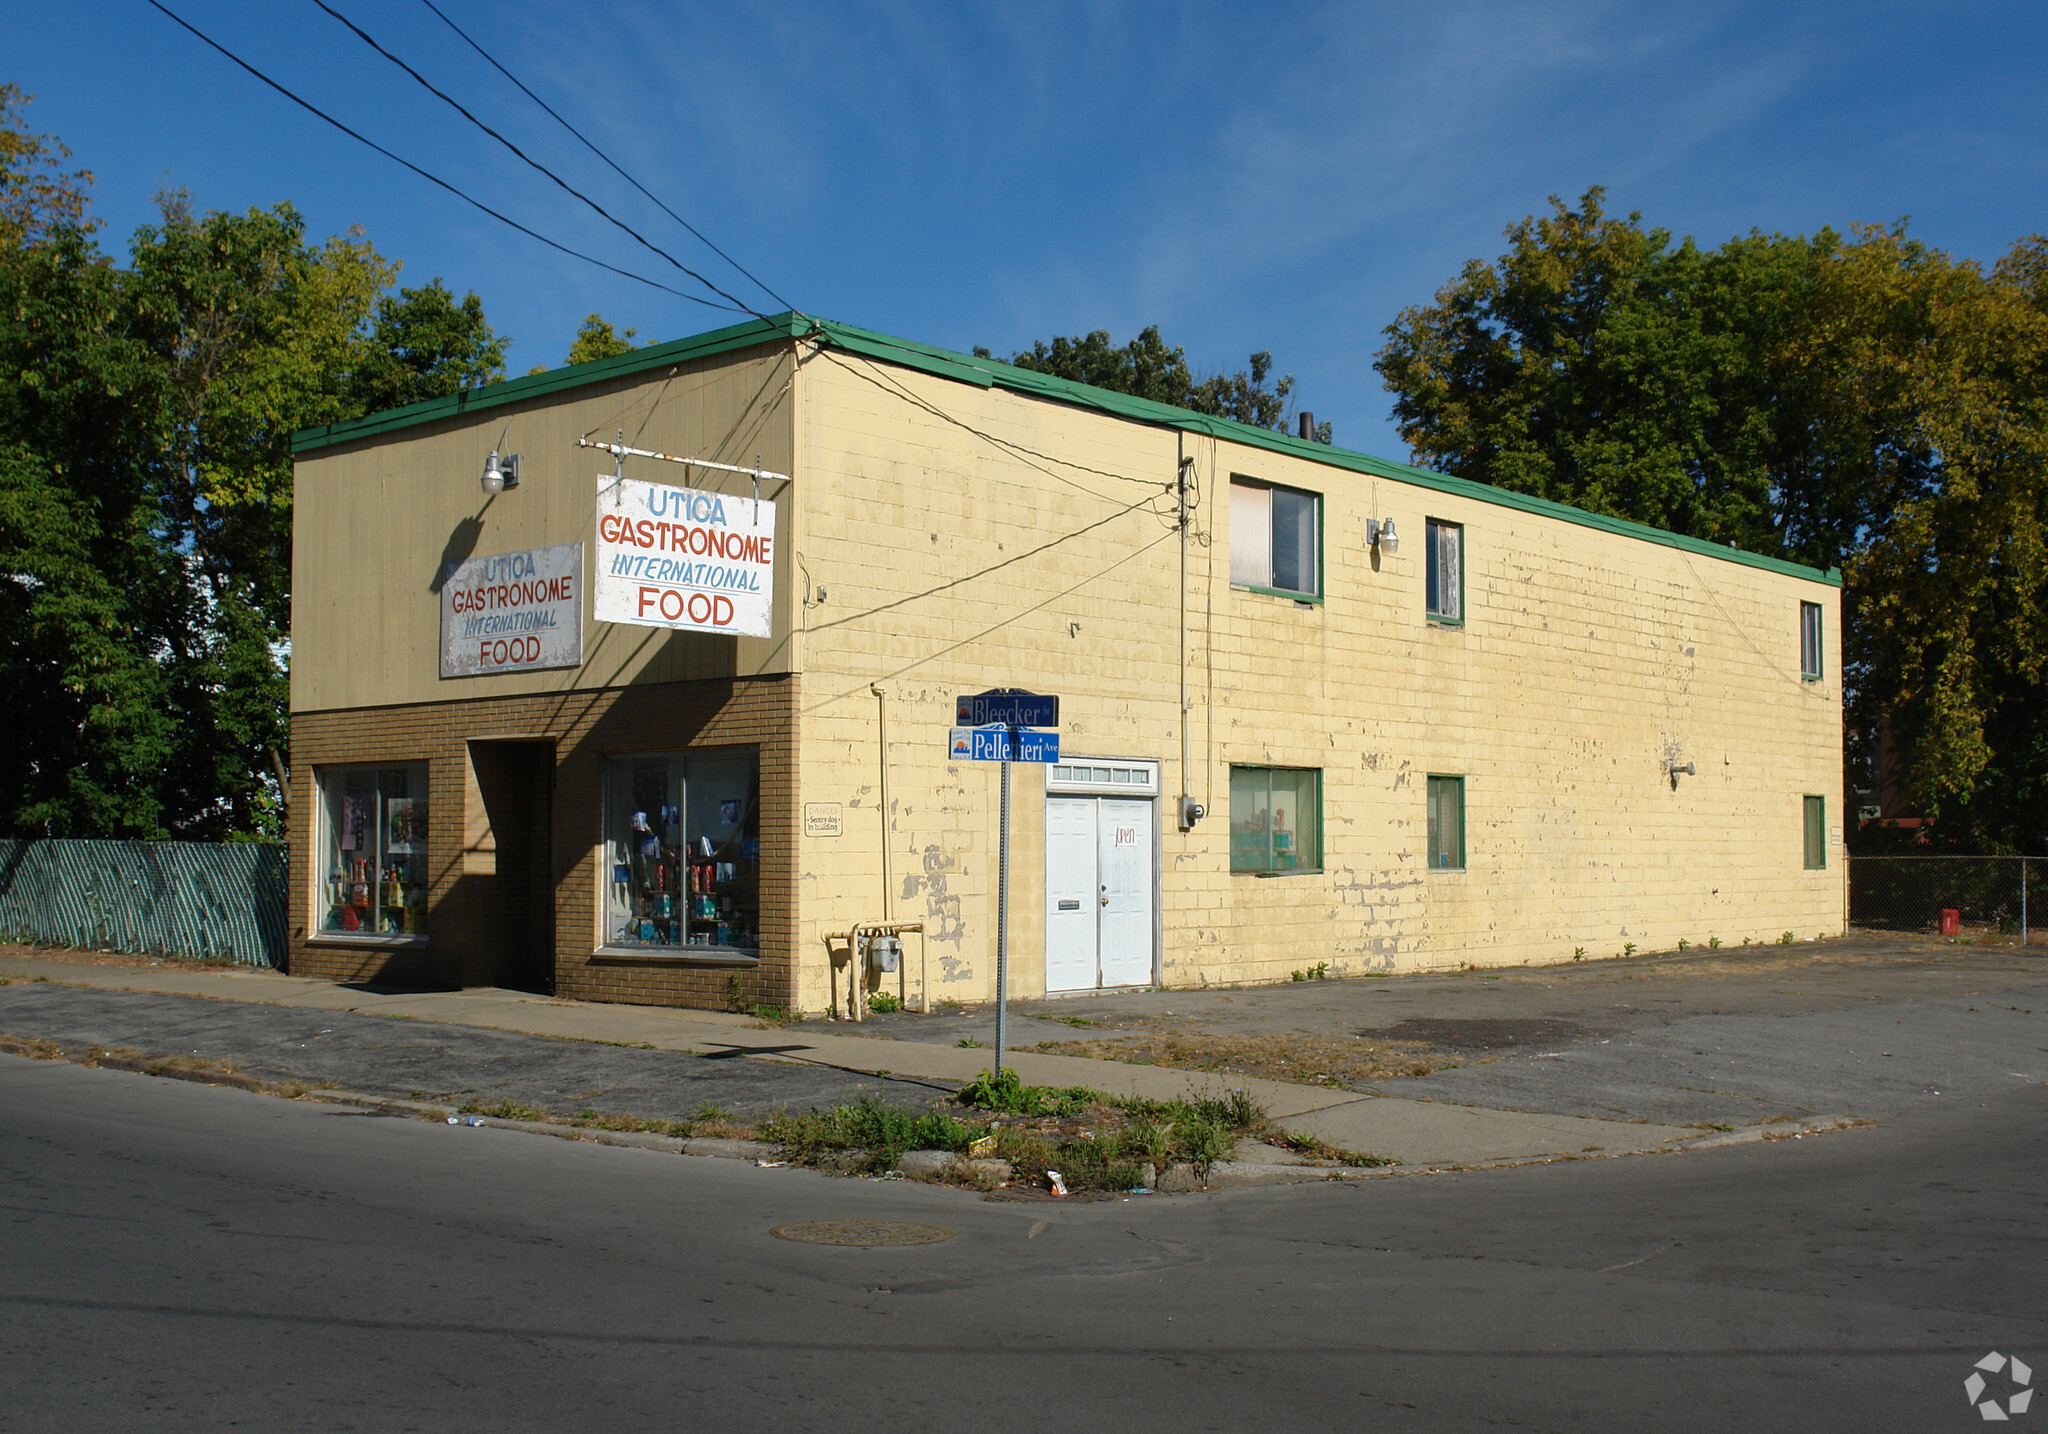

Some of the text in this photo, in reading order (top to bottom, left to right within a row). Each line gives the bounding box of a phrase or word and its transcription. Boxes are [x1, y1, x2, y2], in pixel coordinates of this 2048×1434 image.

[649, 488, 727, 526] UTICA
[600, 514, 772, 565] GASTRONOME
[485, 553, 536, 582] UTICA
[610, 553, 760, 591] INTERNATIONAL
[452, 576, 572, 613] GASTRONOME
[638, 586, 734, 626] FOOD
[464, 609, 557, 636] INTERNATIONAL
[480, 636, 541, 667] FOOD
[974, 699, 1040, 725] Bleecker
[1043, 742, 1059, 752] Ave
